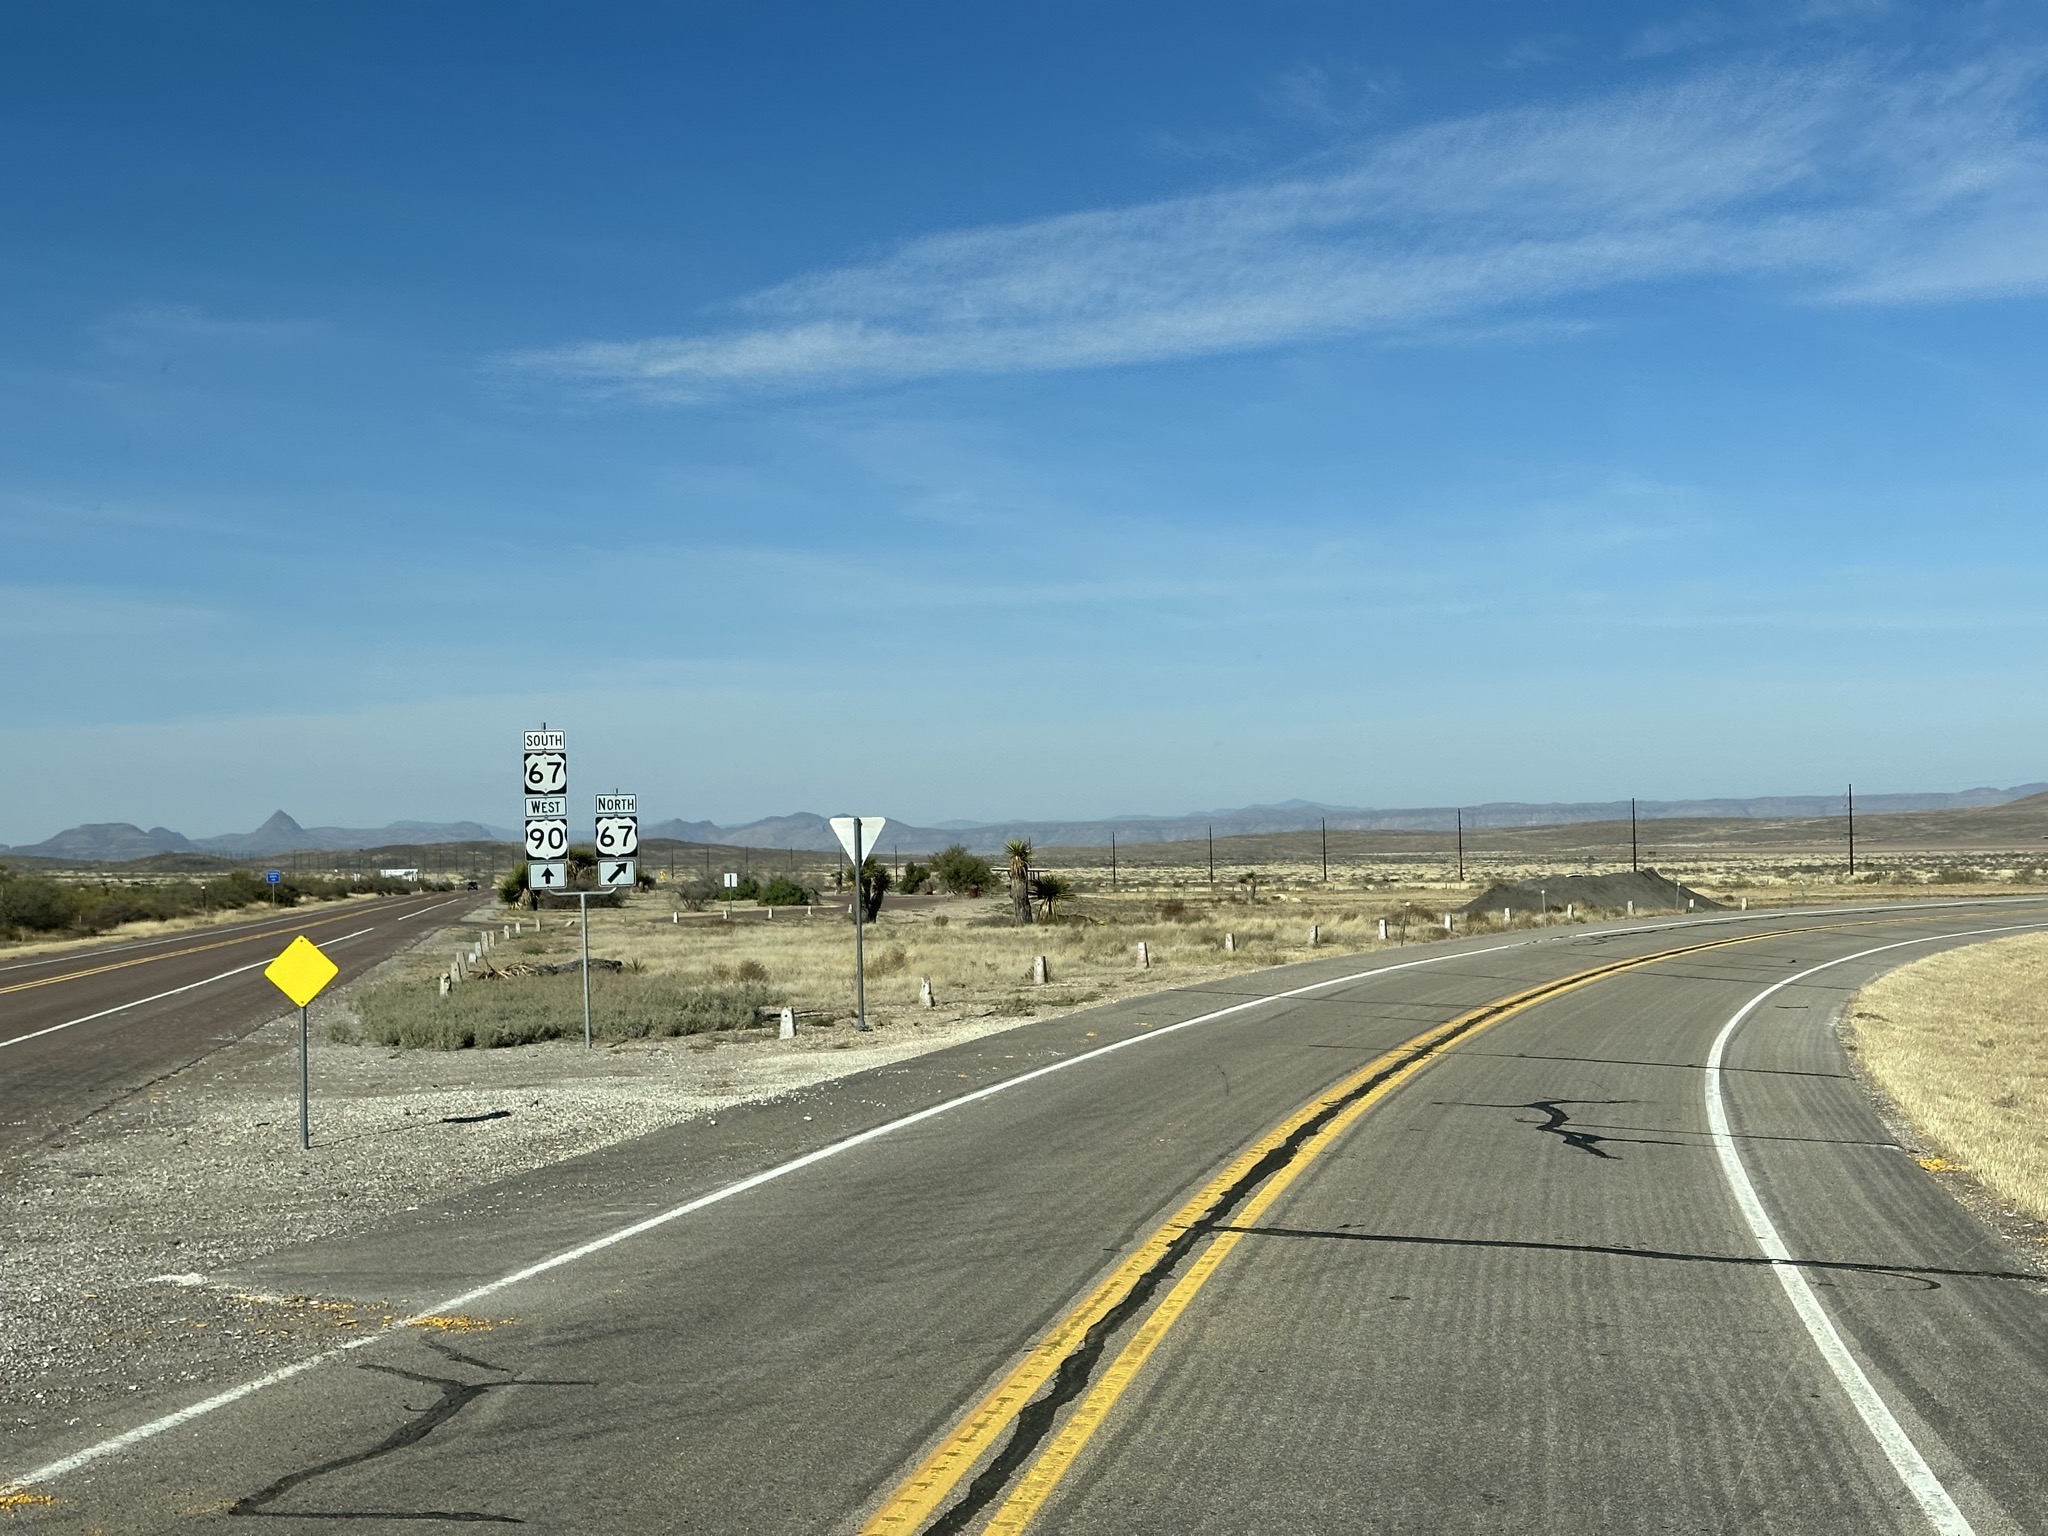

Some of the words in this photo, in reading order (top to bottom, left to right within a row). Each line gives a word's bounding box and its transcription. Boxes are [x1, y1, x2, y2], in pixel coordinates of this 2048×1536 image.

[526, 734, 562, 747] SOUTH
[528, 761, 562, 784] 67
[531, 800, 561, 814] WEST
[598, 797, 635, 811] NORTH
[529, 827, 564, 850] 90
[599, 825, 633, 848] 67
